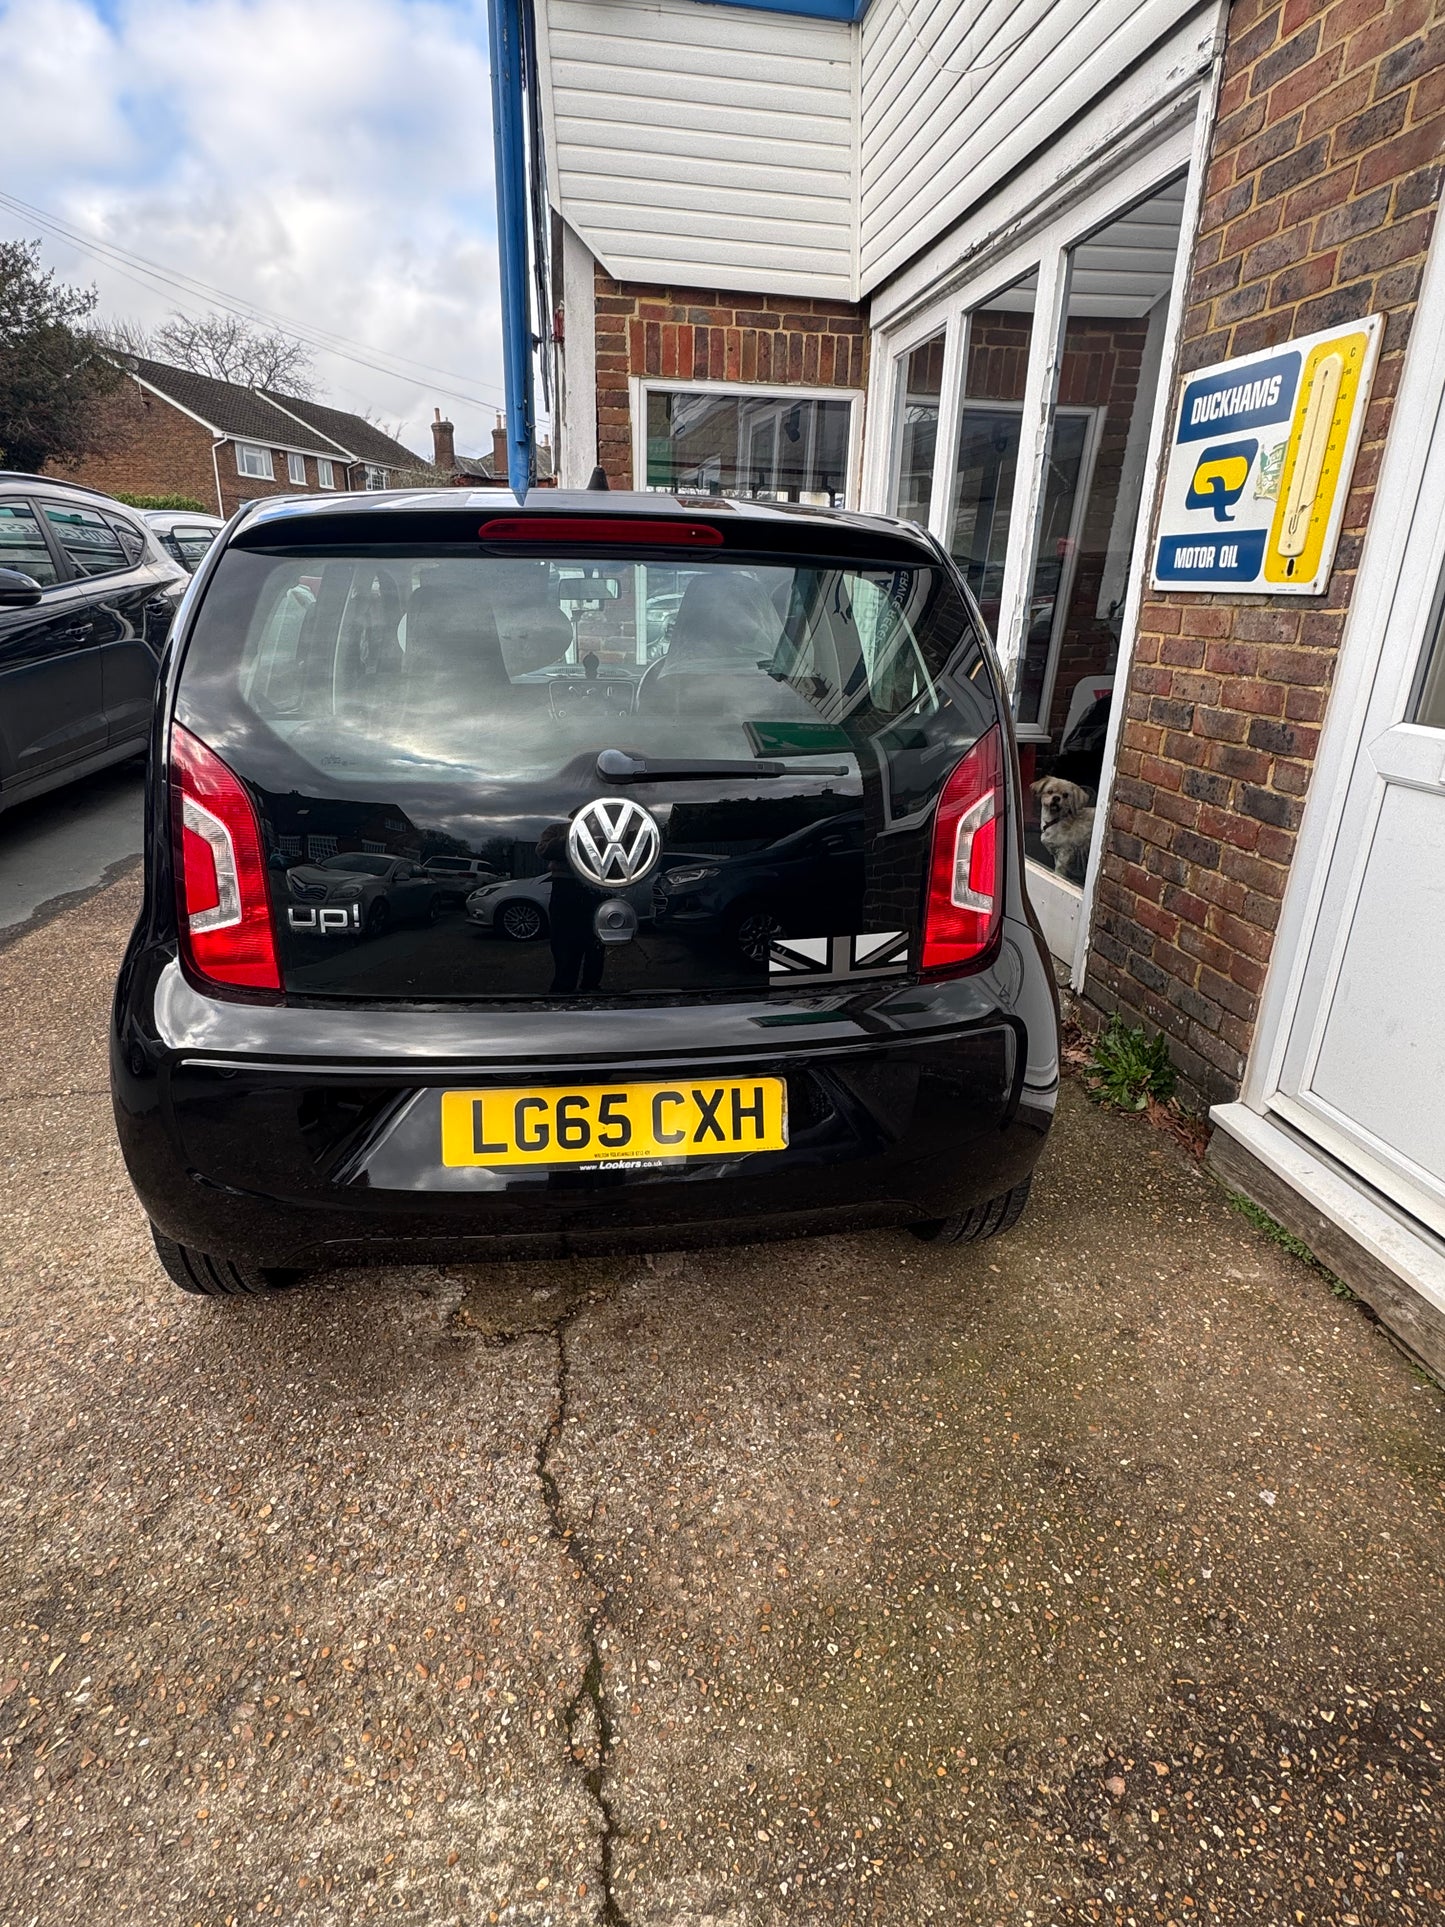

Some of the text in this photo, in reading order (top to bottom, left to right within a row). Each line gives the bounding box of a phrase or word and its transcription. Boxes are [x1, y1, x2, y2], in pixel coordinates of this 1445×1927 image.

[1350, 347, 1356, 357] C
[1190, 375, 1282, 425] DUCKHAMS
[1174, 545, 1238, 568] MOTOR OIL
[288, 904, 360, 933] up!
[473, 1087, 765, 1154] LG65 CXH
